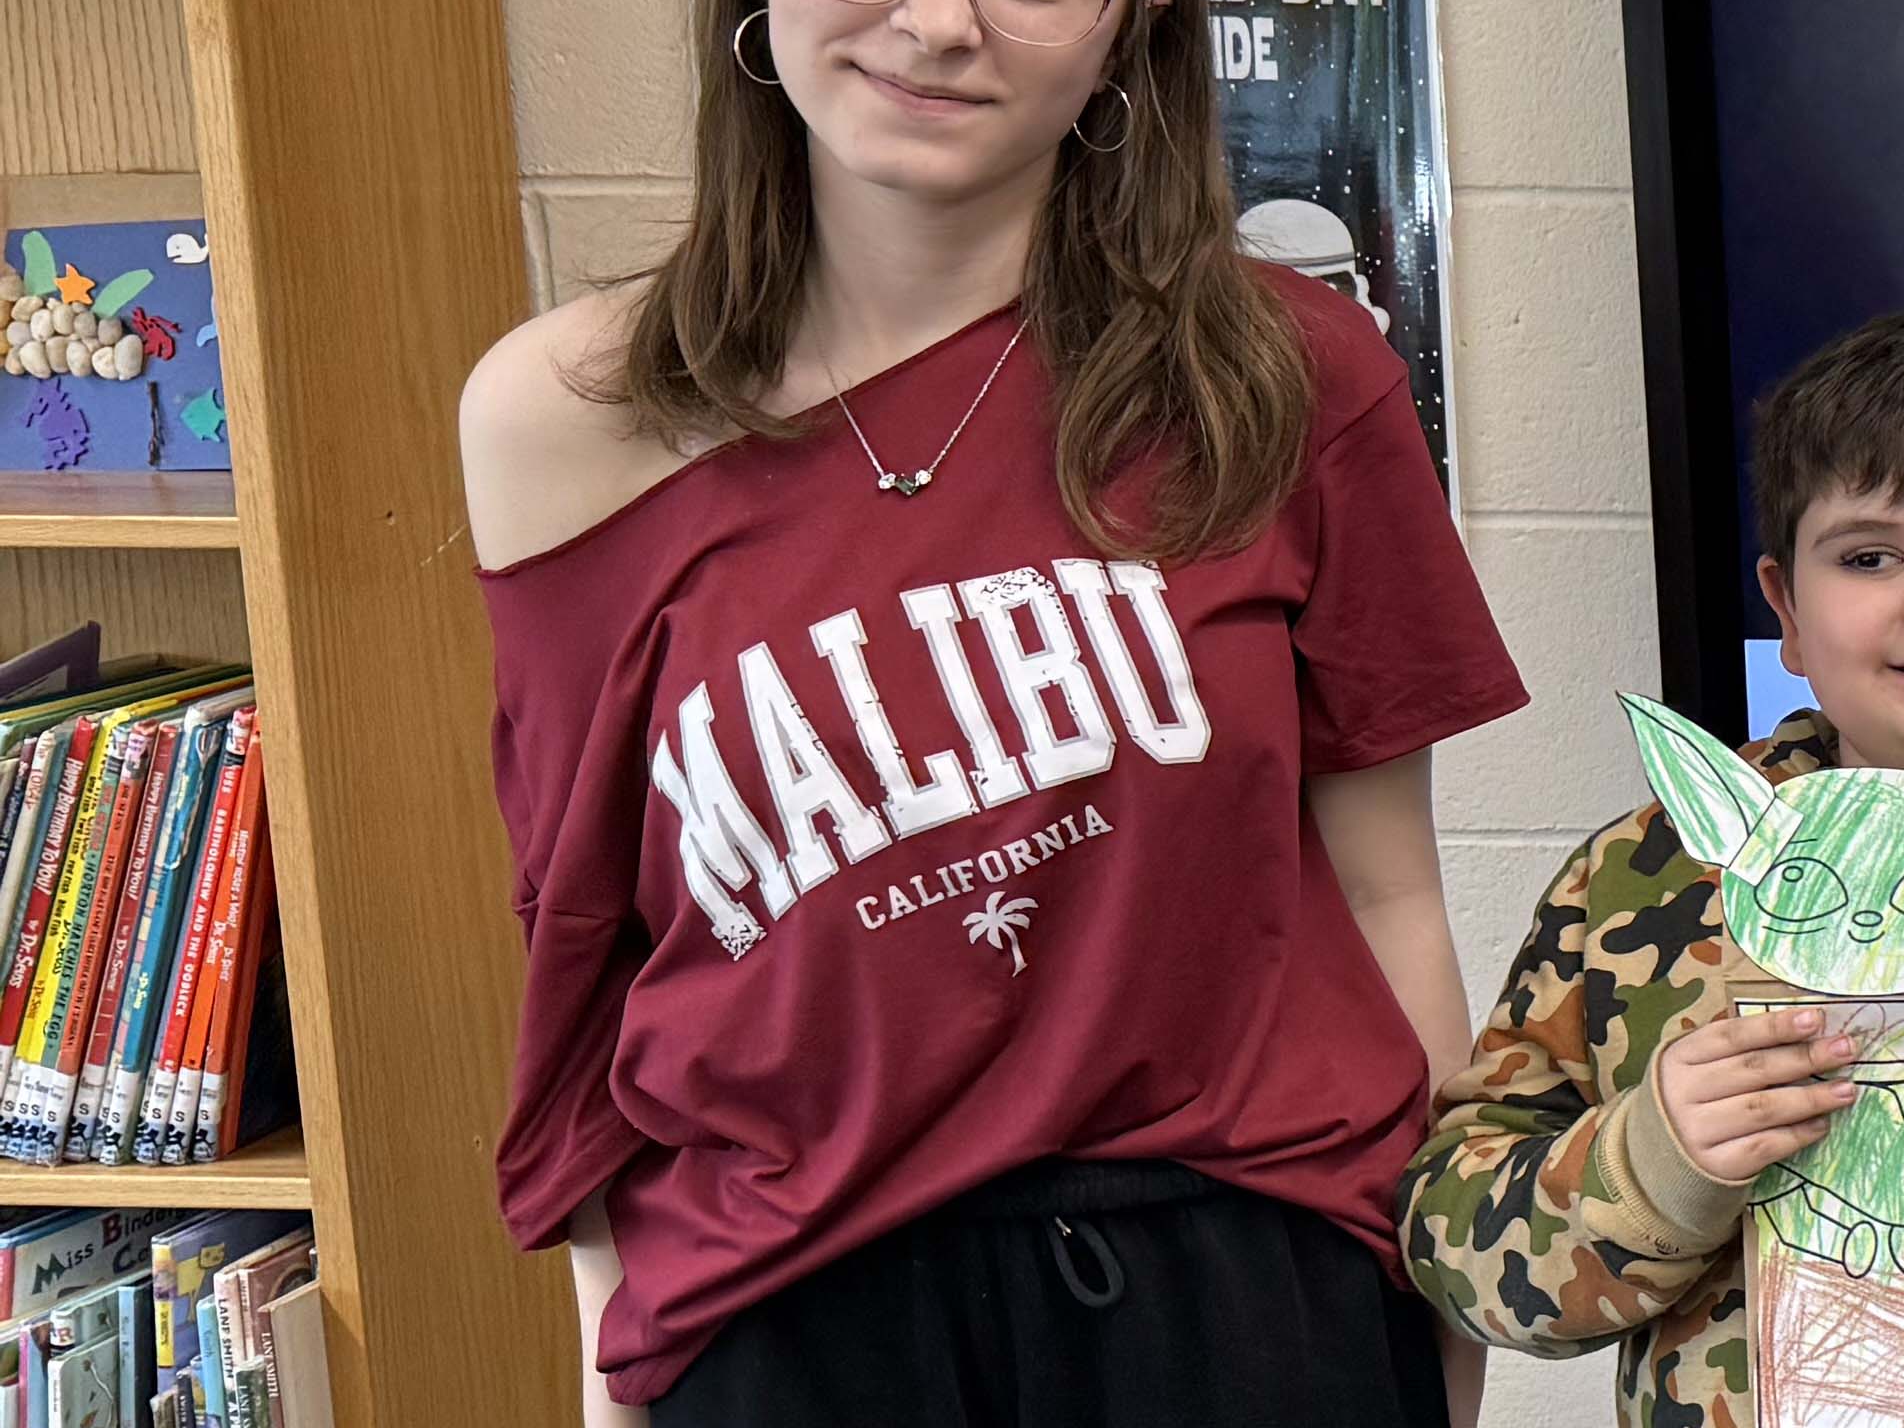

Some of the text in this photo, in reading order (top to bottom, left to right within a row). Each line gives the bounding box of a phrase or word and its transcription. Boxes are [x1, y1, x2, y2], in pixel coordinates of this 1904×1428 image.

[651, 557, 1212, 961] MALIBU
[174, 808, 227, 1017] BARTHOLOMEW AND THE OOBLECK
[854, 803, 1114, 931] CALIFORNIA
[8, 953, 33, 990] Seuss
[16, 931, 38, 956] Dr.
